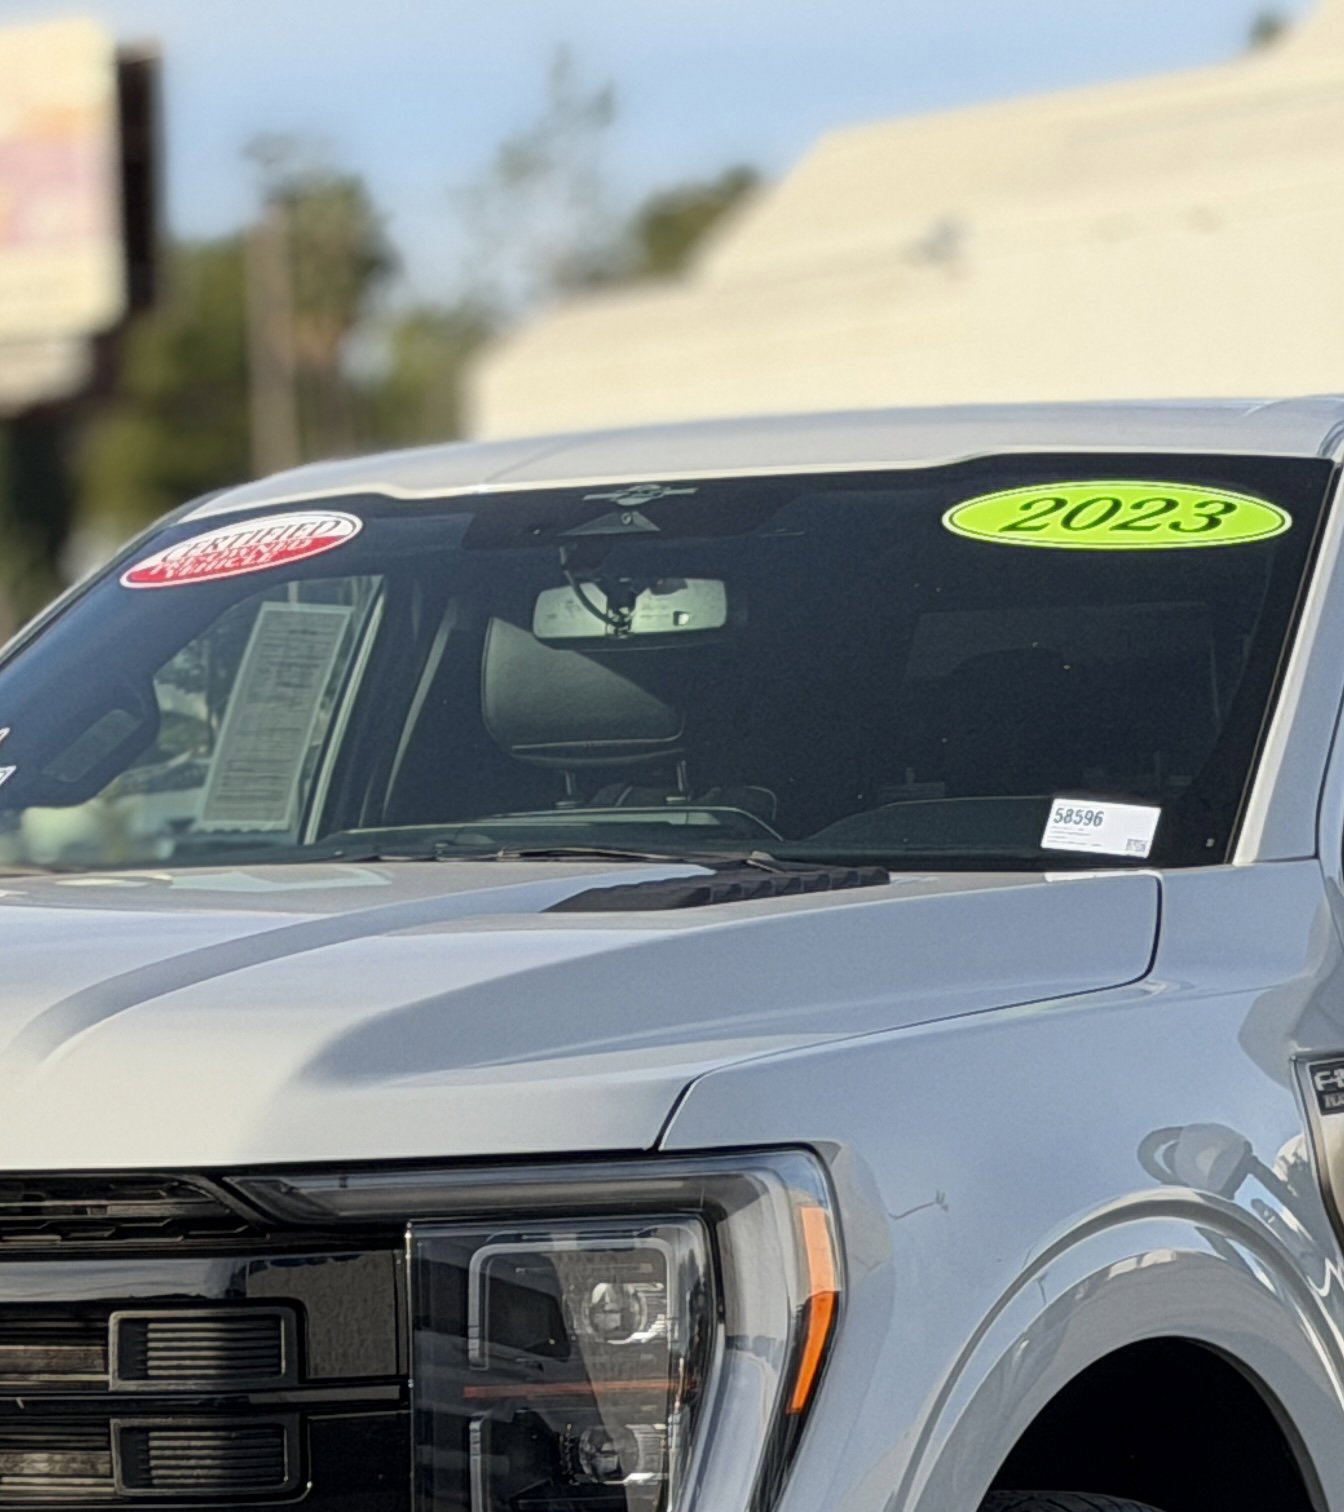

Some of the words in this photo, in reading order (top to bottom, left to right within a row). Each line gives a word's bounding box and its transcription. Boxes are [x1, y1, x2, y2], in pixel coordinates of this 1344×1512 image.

[998, 496, 1237, 534] 2023
[161, 519, 341, 564] CERTIFIED
[1053, 807, 1105, 828] 58596
